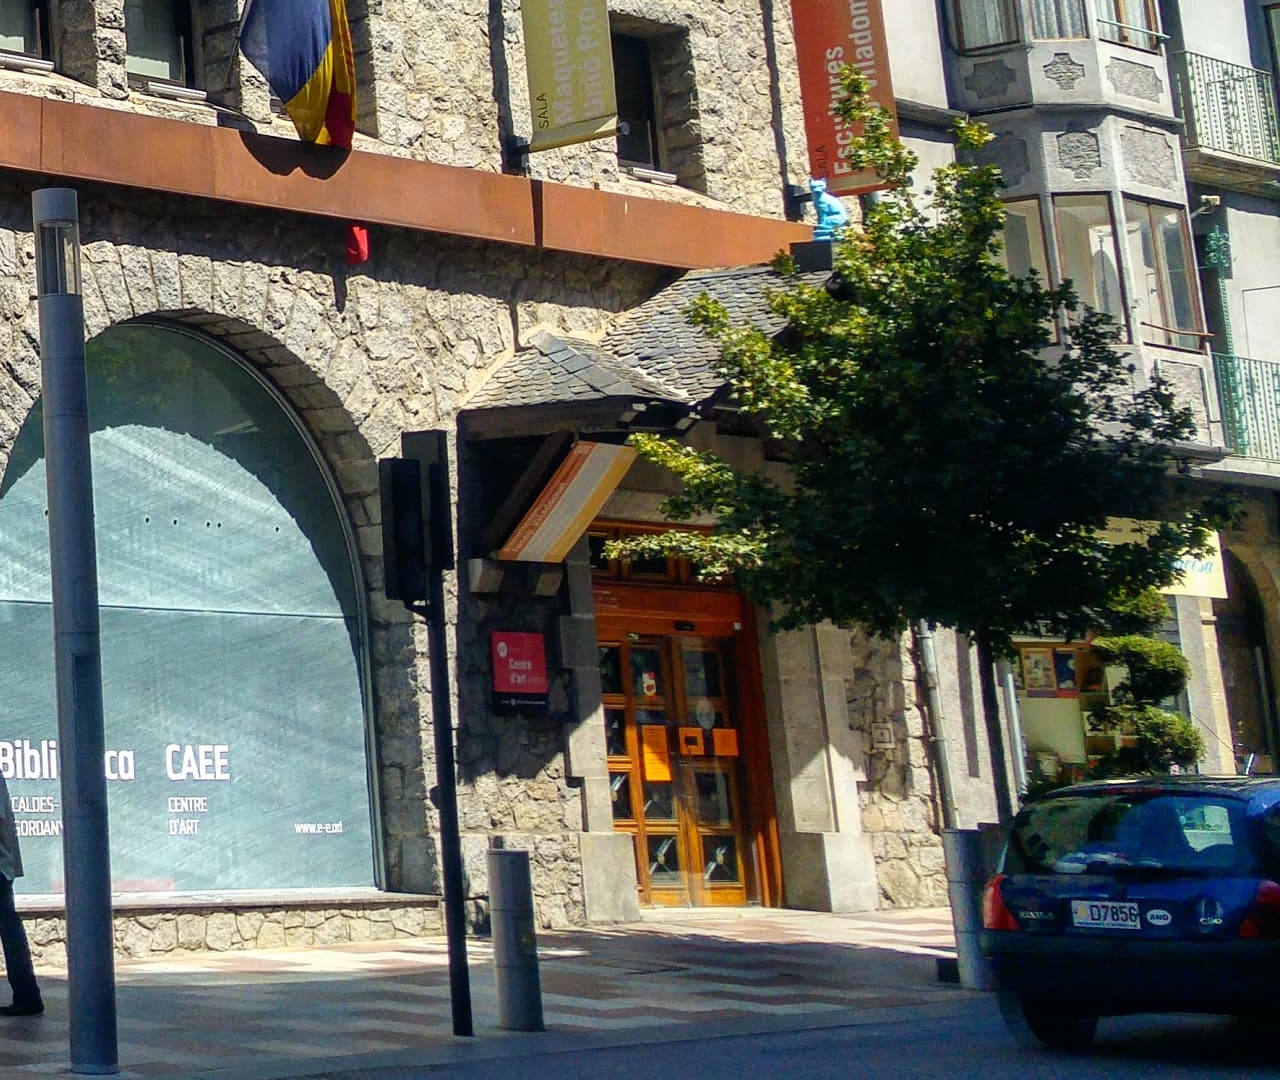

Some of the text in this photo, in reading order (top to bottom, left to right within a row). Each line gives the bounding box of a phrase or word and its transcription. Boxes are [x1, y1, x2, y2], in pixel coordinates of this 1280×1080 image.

[580, 55, 605, 117] Unió
[536, 92, 550, 129] SALA
[165, 743, 230, 781] CAEE
[12, 796, 60, 813] CALDES-
[167, 796, 208, 813] CENTRE
[14, 819, 64, 837] GORDANY
[169, 819, 200, 835] D'ART
